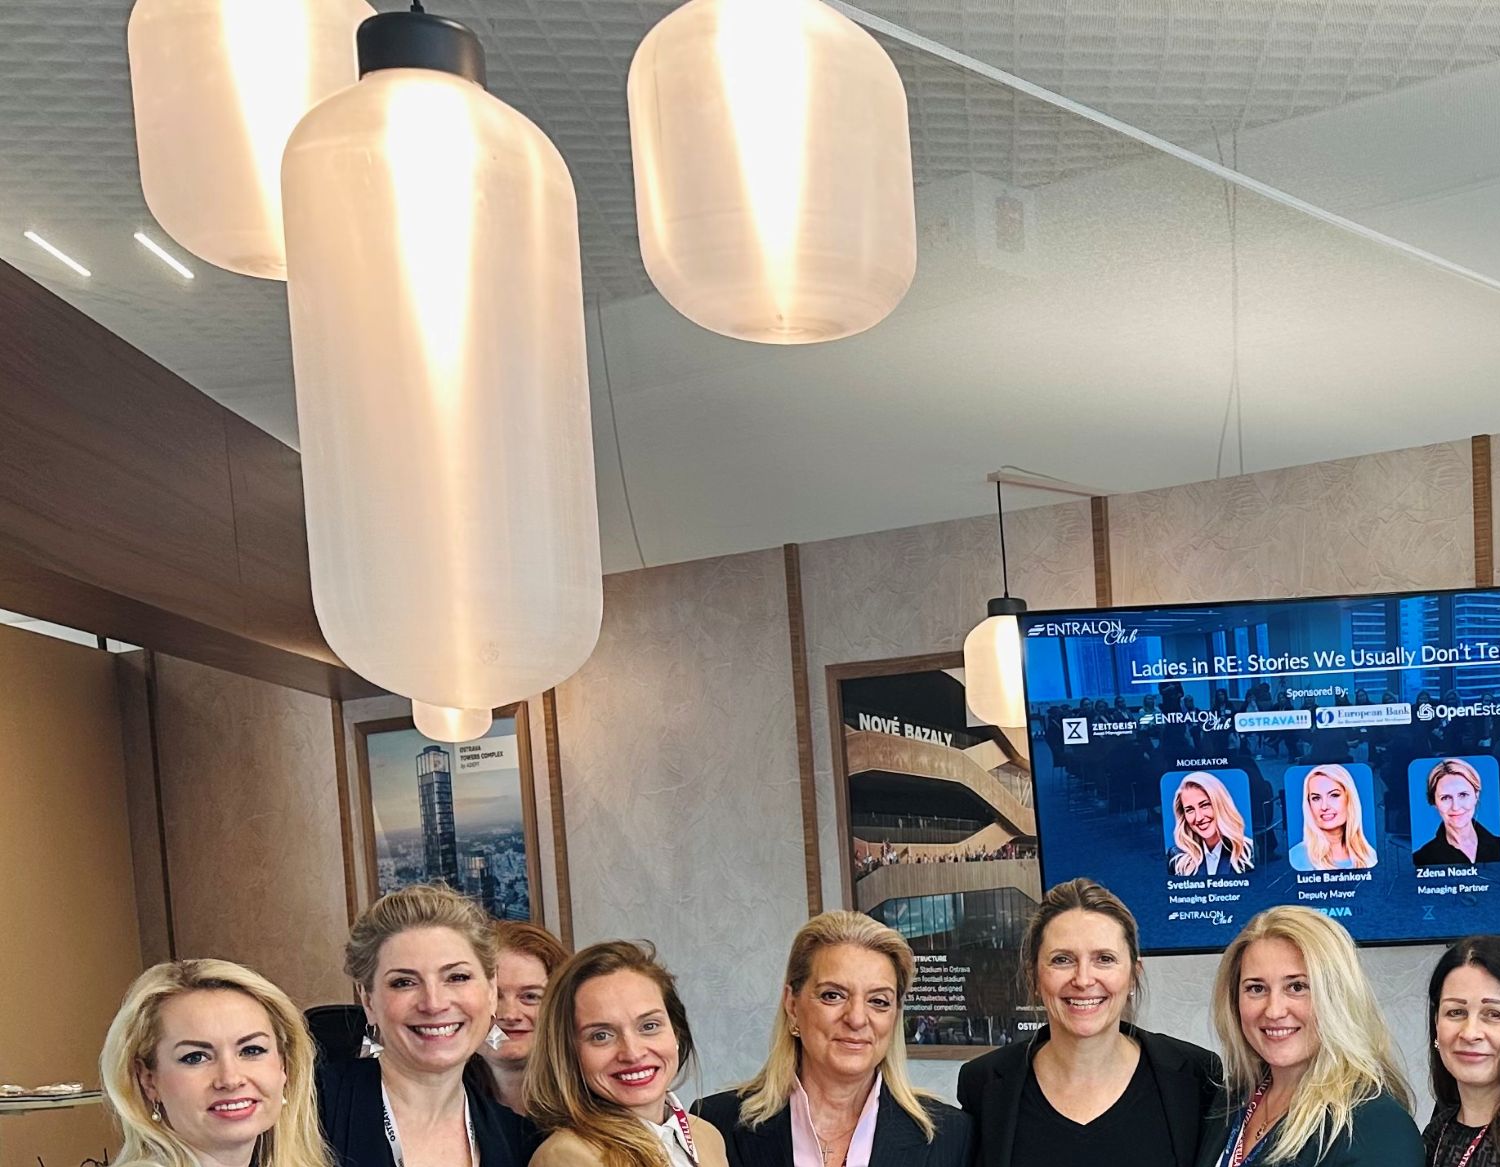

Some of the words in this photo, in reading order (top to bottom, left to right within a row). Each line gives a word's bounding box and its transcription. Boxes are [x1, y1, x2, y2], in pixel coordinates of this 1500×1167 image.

[1047, 619, 1121, 636] ENTRALON
[1104, 628, 1138, 645] Club
[1132, 659, 1187, 677] Ladies
[1192, 657, 1209, 675] in
[1214, 656, 1243, 673] RE:
[1247, 652, 1309, 672] Stories
[1313, 650, 1346, 668] We
[1351, 646, 1416, 667] Usually
[1422, 643, 1472, 662] Don’t
[1286, 686, 1332, 700] Sponsored
[1335, 685, 1349, 697] By:
[1155, 711, 1218, 725] ENTRALON
[1338, 708, 1382, 720] European
[1385, 706, 1411, 716] Bank
[858, 712, 900, 737] NOVÉ
[904, 723, 953, 748] BAZALY
[1091, 721, 1137, 731] ZEITGEIST
[1202, 717, 1232, 732] Club
[1176, 757, 1229, 768] MODERATOR
[1297, 873, 1321, 883] Lucie
[1323, 871, 1372, 882] Baránková
[1416, 868, 1446, 878] Zdena
[1447, 867, 1478, 877] Noack
[1167, 880, 1206, 890] Svetlana
[1207, 878, 1250, 889] Fedosova
[1418, 884, 1457, 894] Managing
[1459, 884, 1489, 893] Partner
[1169, 894, 1207, 904] Managing
[1208, 893, 1241, 902] Director
[1298, 891, 1328, 900] Deputy
[1329, 890, 1356, 899] Mayor
[1180, 911, 1224, 920] ENTRALON
